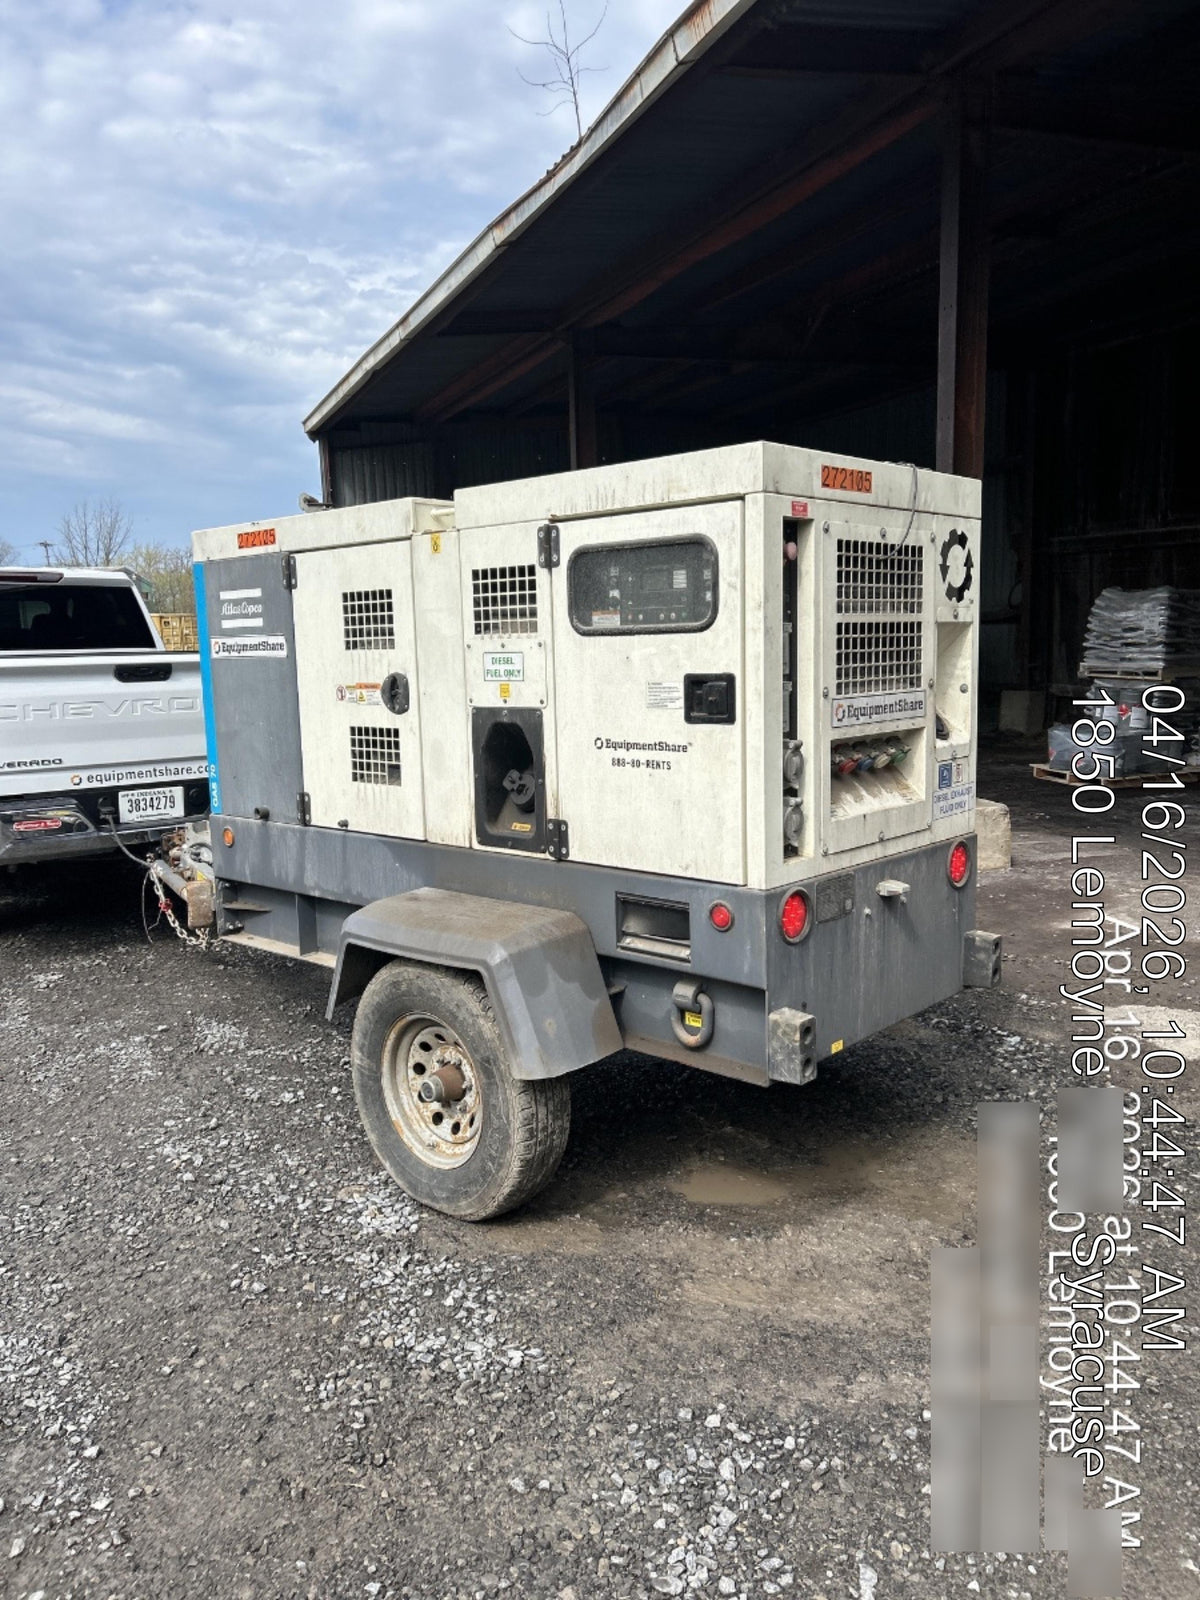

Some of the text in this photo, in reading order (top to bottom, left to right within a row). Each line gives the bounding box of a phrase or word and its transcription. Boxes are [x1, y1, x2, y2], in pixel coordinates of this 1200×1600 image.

[822, 465, 872, 492] 272105
[239, 529, 276, 548] 272105
[221, 601, 262, 616] Atlas Copco
[221, 640, 285, 654] EquipmentShare
[491, 656, 515, 665] DIESEL
[486, 669, 521, 678] FUEL ONLY
[846, 698, 924, 720] EquipmentShare
[605, 739, 688, 752] EquipmentShare
[611, 757, 672, 770] 888-80-RENTS
[136, 789, 167, 797] INDIANA
[127, 794, 176, 813] 3834279
